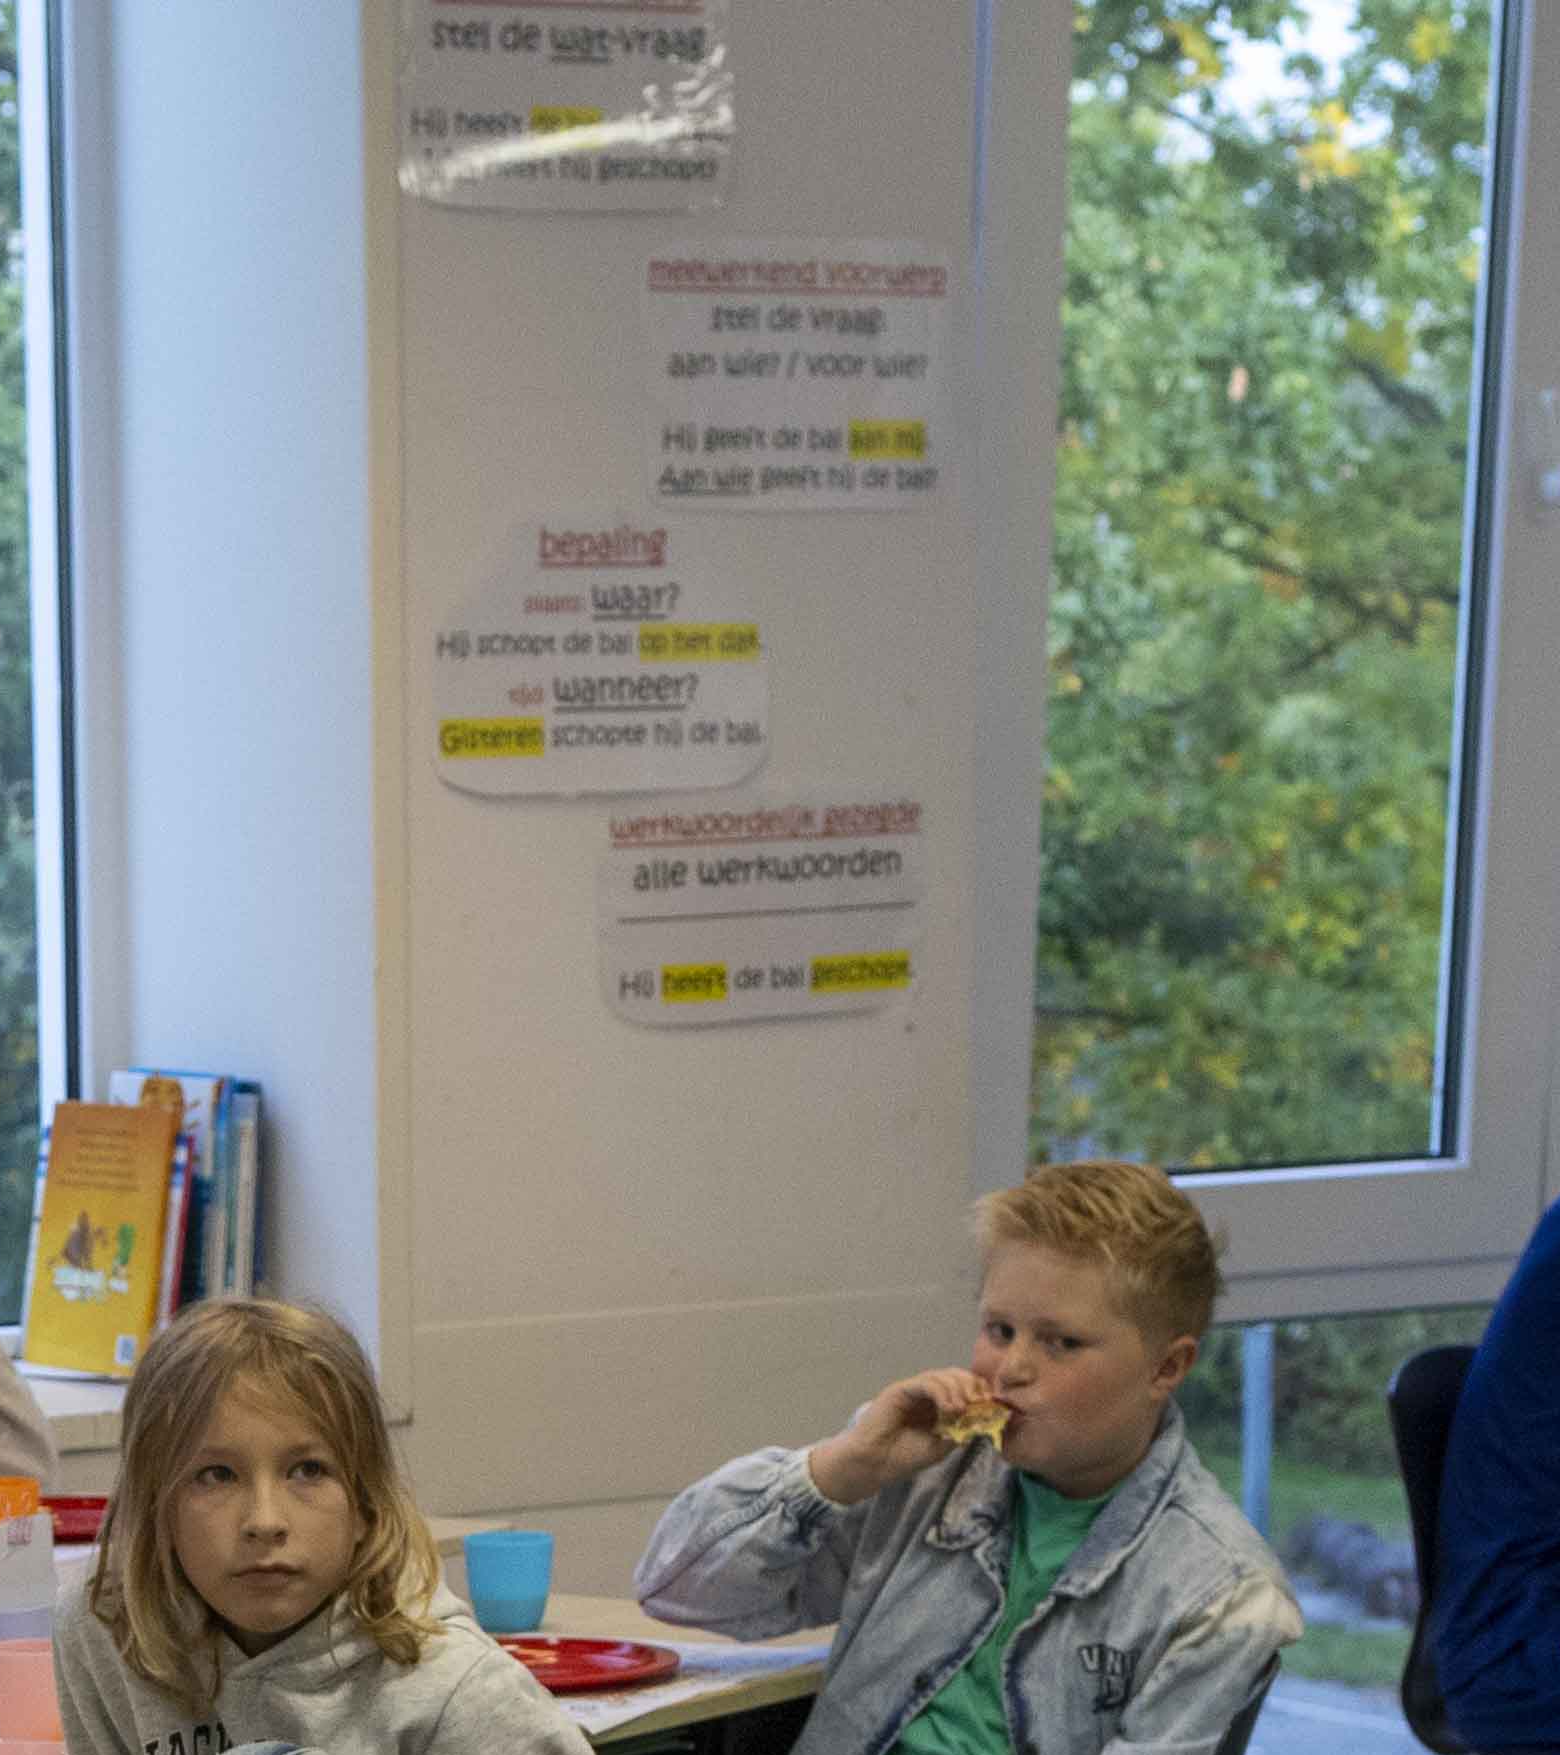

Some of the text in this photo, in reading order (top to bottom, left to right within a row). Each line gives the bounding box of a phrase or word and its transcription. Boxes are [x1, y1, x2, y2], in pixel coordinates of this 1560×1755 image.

[499, 22, 542, 50] de
[806, 354, 865, 377] voor
[540, 526, 667, 564] bepaling
[591, 582, 680, 613] waar?
[563, 632, 592, 652] de
[553, 672, 699, 705] wanneer?
[690, 722, 718, 744] de
[633, 849, 902, 891] alle werkwoorden
[735, 966, 764, 990] de
